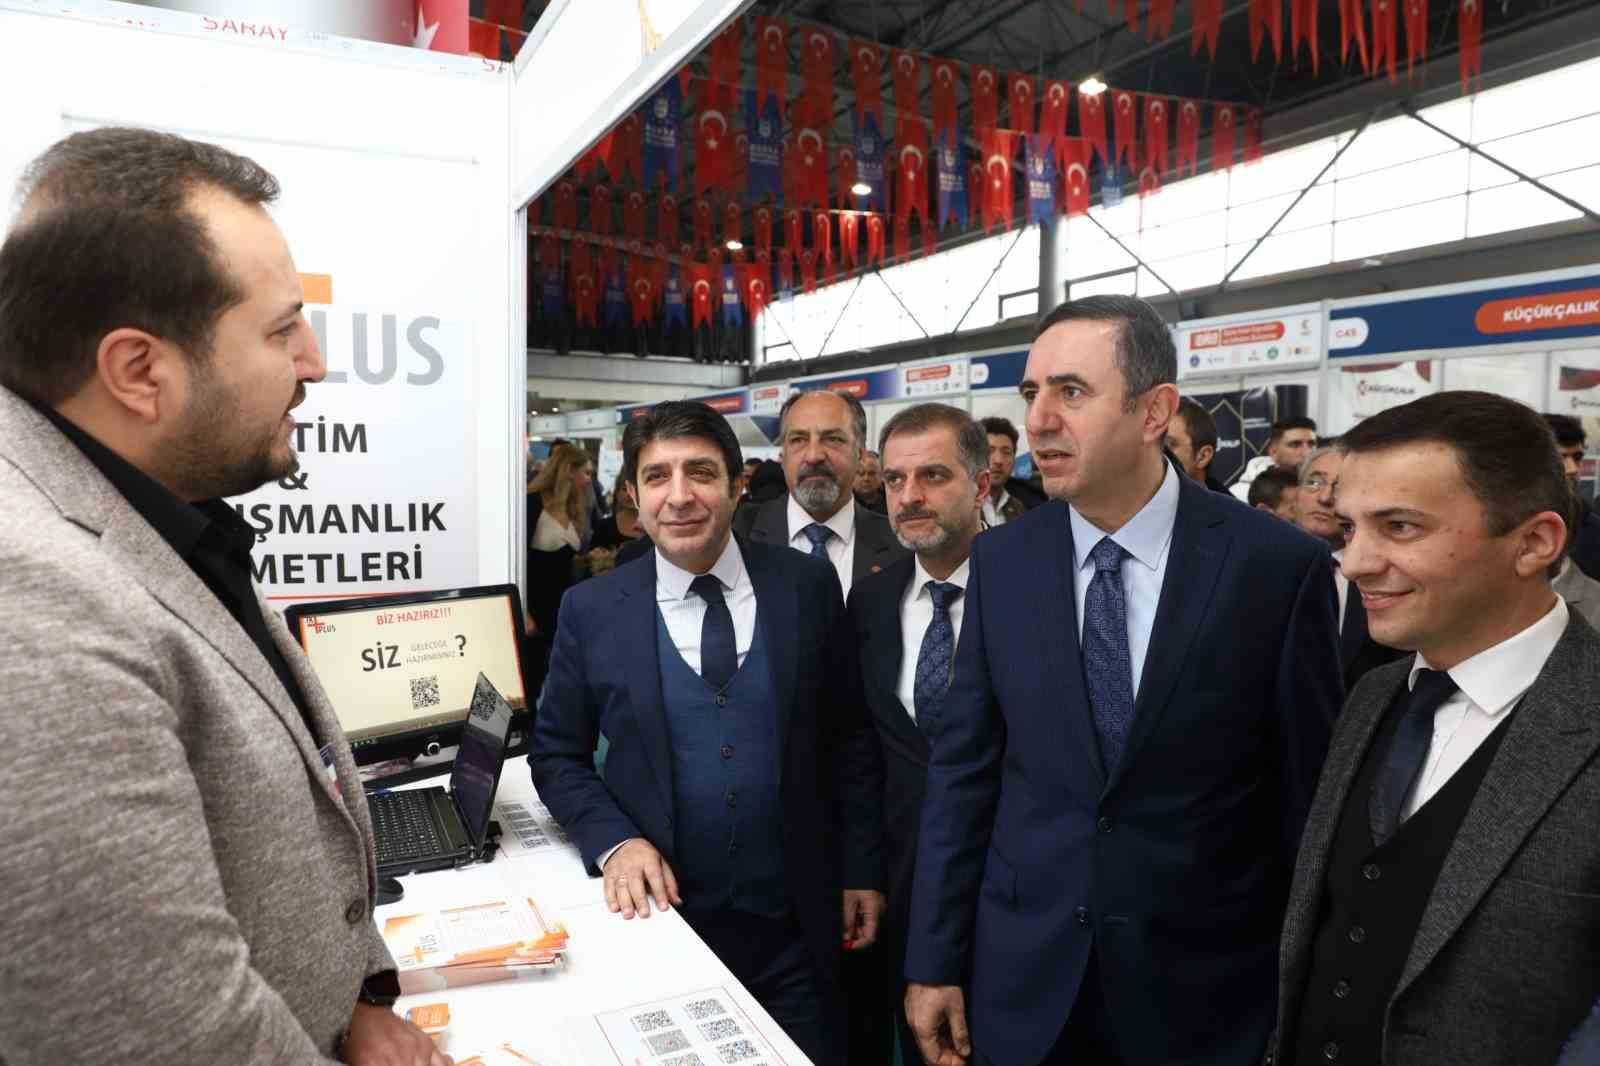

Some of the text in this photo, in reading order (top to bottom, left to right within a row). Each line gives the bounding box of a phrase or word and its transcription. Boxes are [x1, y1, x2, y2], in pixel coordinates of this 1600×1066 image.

[1503, 299, 1600, 324] KÜÇÜKÇALIK
[310, 310, 445, 386] LUS
[295, 415, 368, 453] TİM
[250, 543, 422, 585] METLERİ
[361, 641, 402, 672] SİZ
